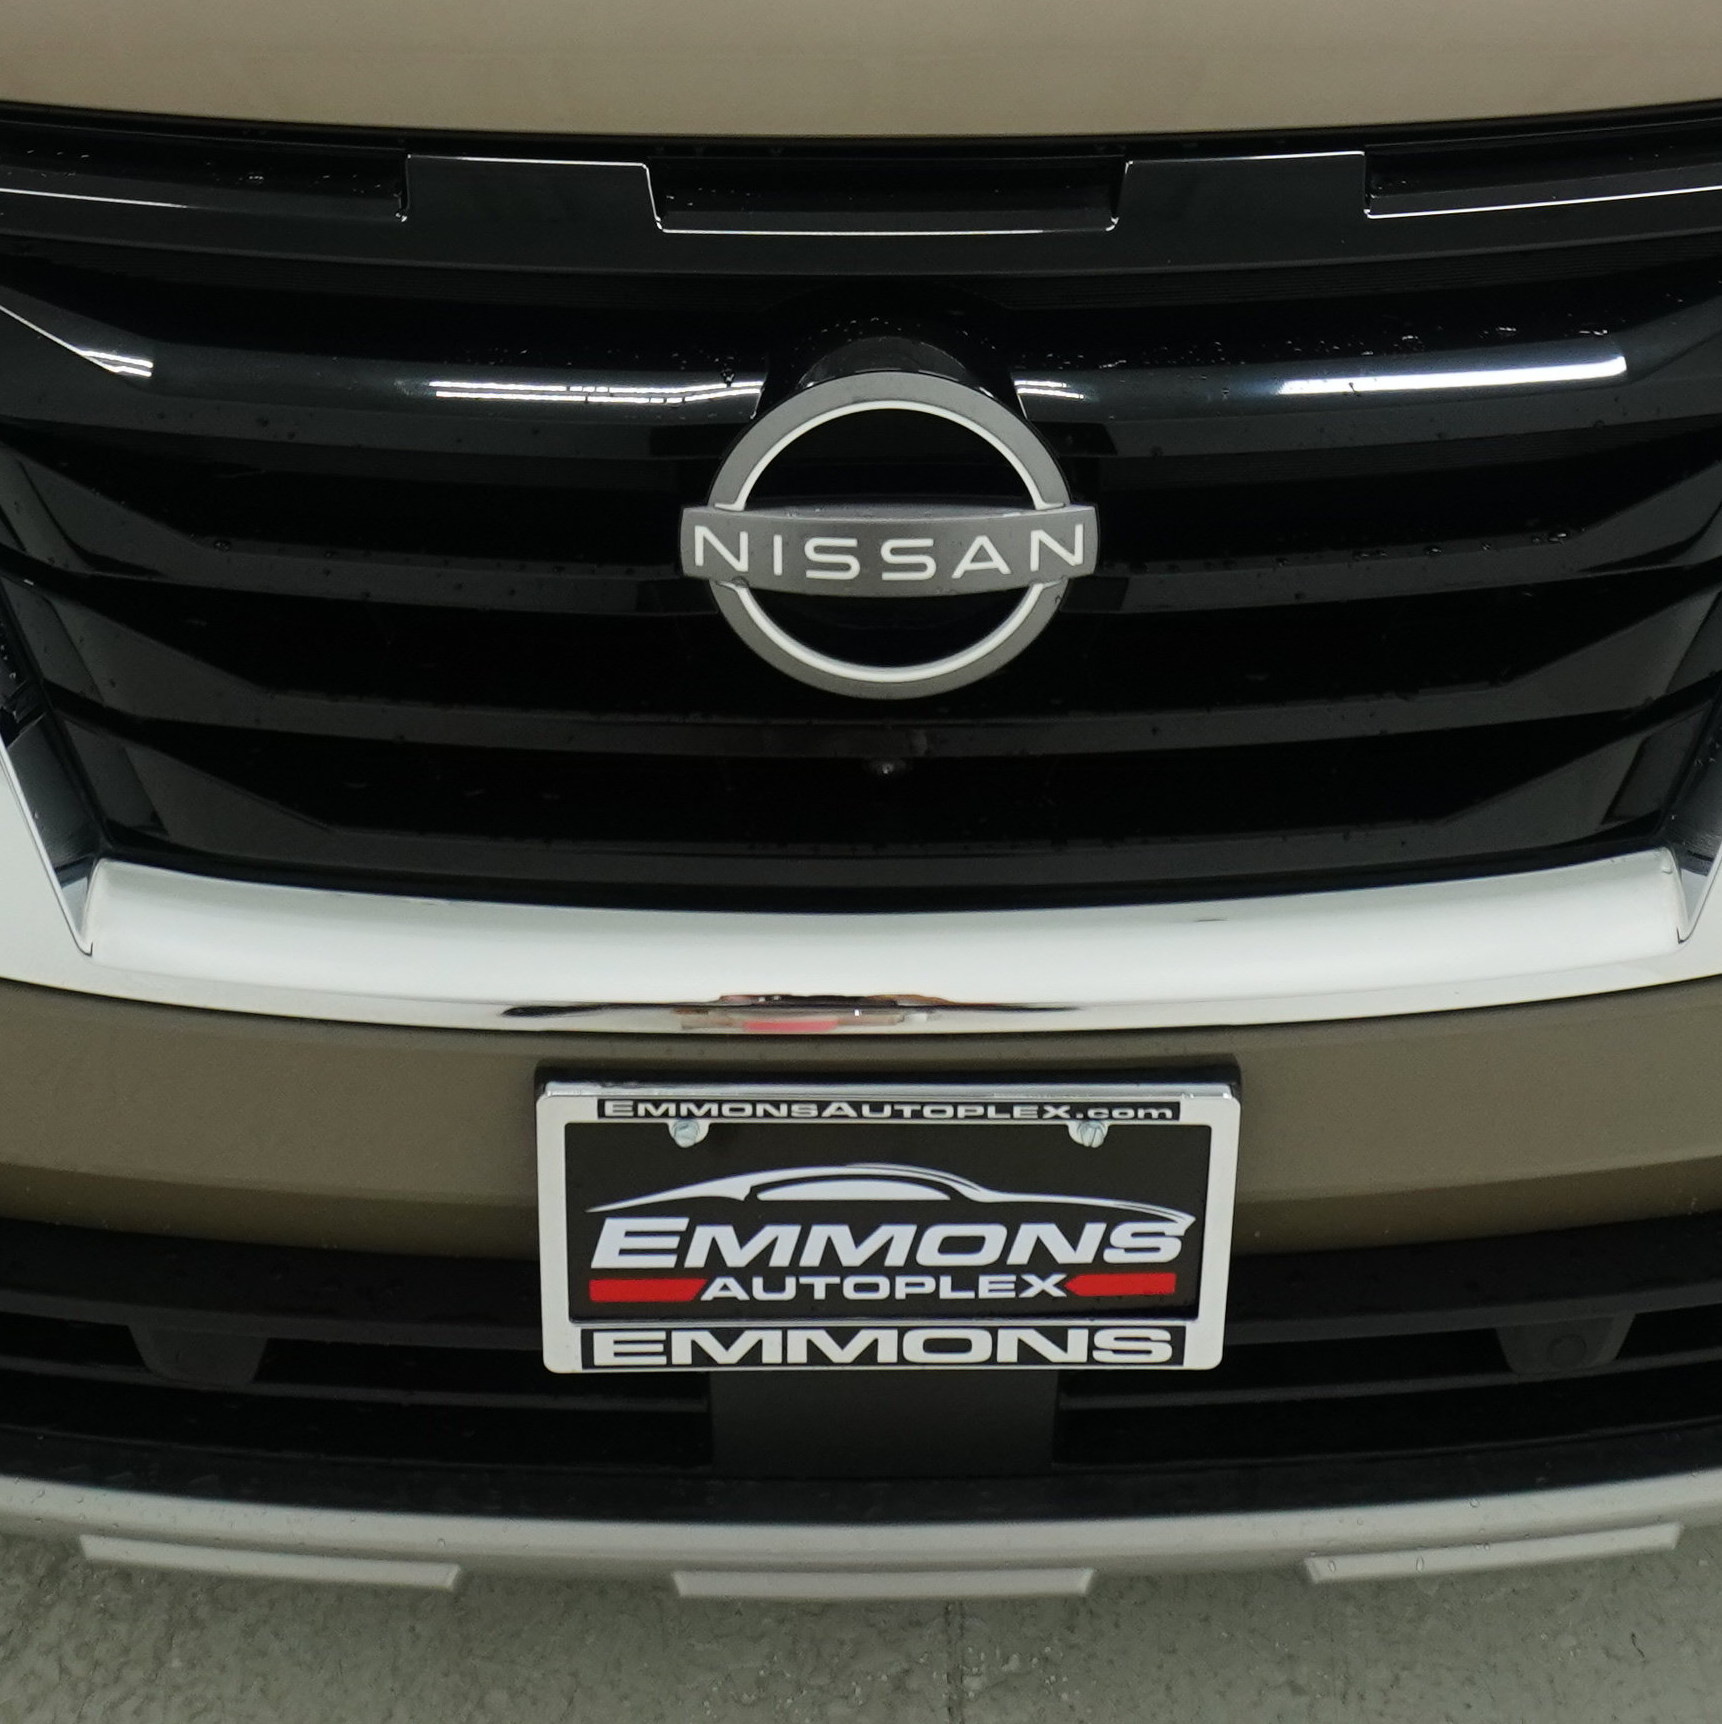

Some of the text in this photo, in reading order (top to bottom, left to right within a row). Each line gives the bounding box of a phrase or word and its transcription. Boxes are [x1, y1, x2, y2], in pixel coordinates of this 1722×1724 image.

[693, 523, 1085, 582] NISSAN
[590, 1216, 1186, 1269] EMMONS
[699, 1273, 1068, 1302] AUTOPLEX
[591, 1326, 1174, 1366] EMMONS
